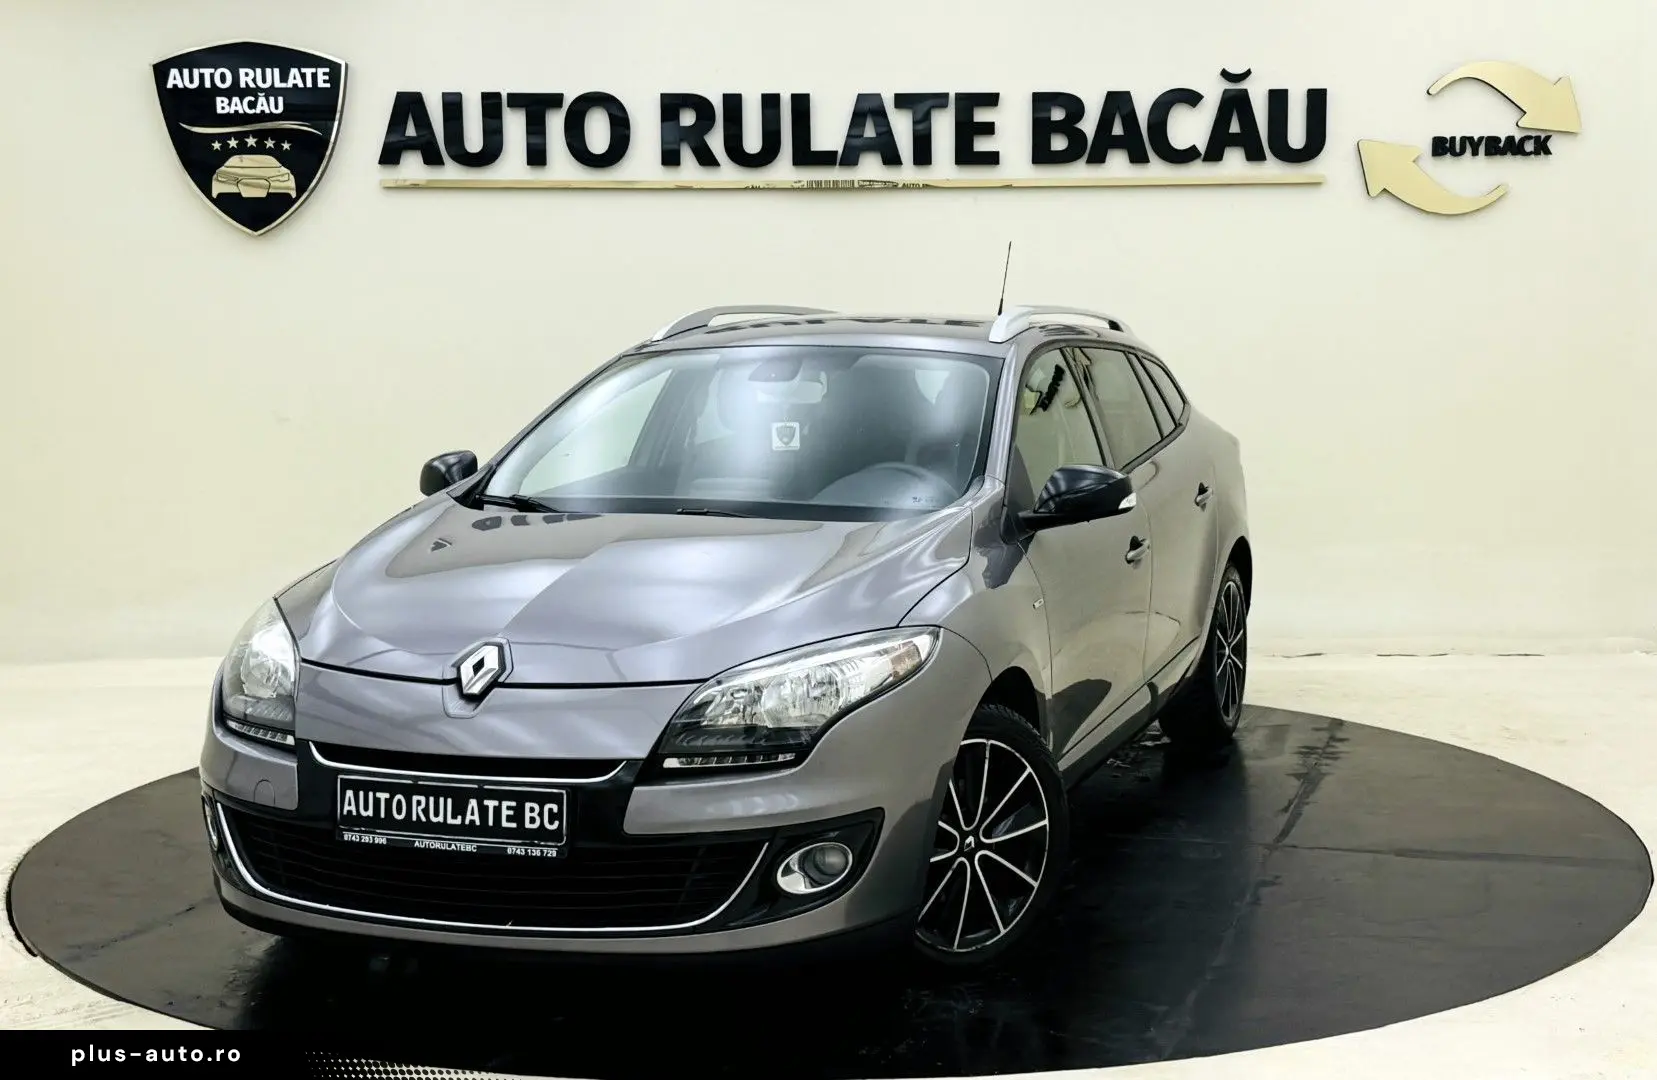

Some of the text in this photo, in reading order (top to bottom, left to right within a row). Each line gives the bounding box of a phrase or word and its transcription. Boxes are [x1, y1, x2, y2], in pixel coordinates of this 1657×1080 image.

[166, 67, 331, 89] AUTO RULATE
[215, 92, 284, 115] BACĂU
[378, 67, 1328, 168] AUTO RULATE BACĂU
[1431, 134, 1553, 157] BUYBACK
[343, 789, 560, 831] AUTO RULATE BC
[414, 840, 478, 852] AUTORULATEBC
[507, 847, 526, 856] 0743
